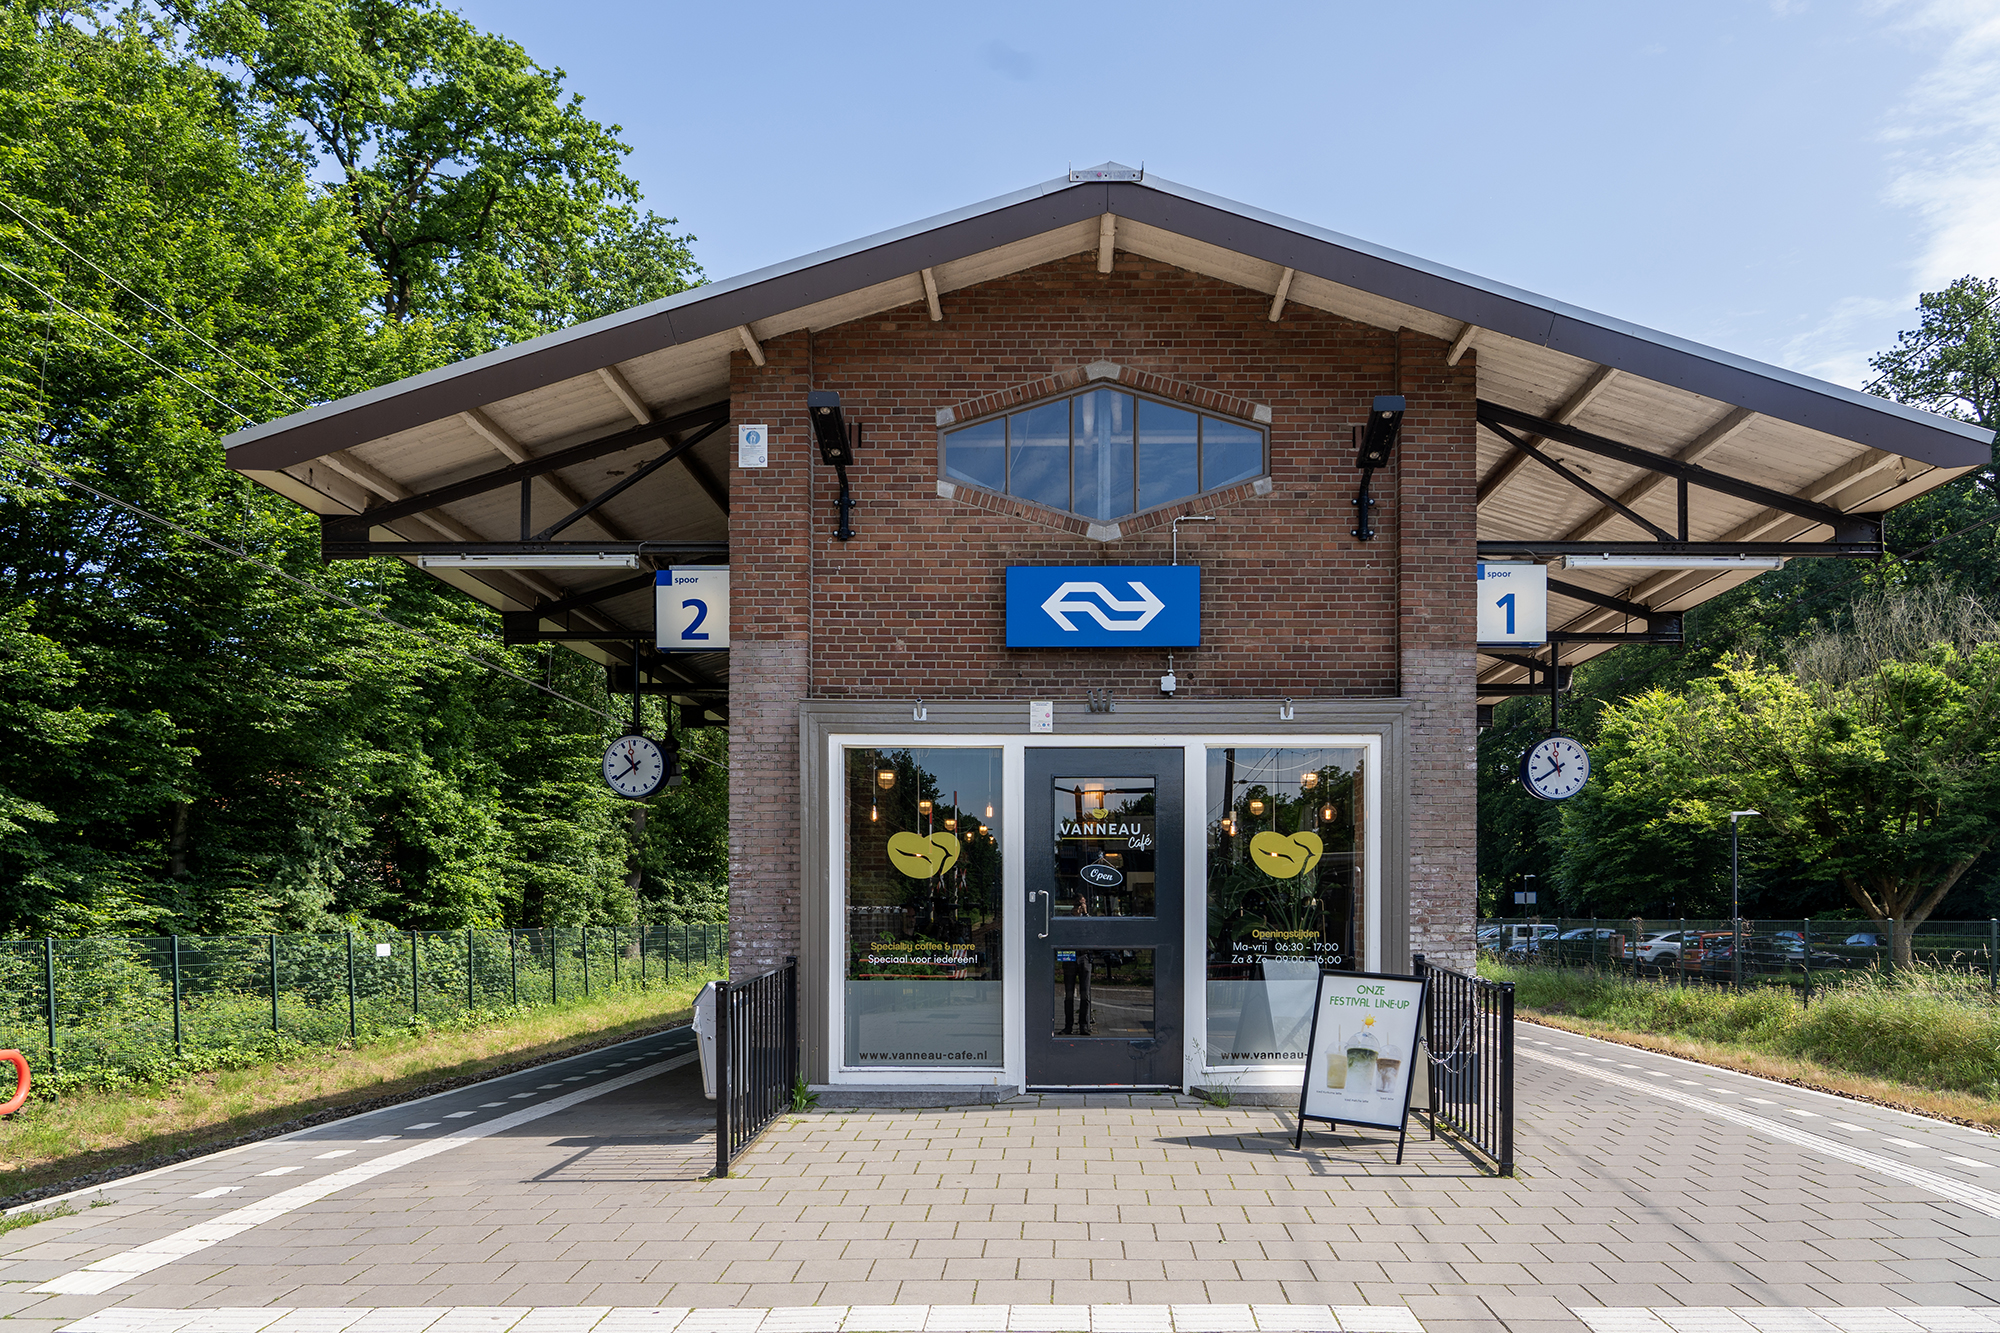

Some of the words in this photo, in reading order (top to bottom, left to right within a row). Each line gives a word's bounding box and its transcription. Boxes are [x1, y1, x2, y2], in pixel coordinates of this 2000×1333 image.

[1487, 571, 1512, 579] spoor
[674, 577, 699, 585] spoor
[681, 598, 709, 640] 2
[1495, 593, 1515, 634] 1
[1060, 823, 1141, 835] VANNEAU
[1128, 833, 1152, 852] Café
[1090, 868, 1113, 881] Open
[1251, 929, 1320, 940] Openingstijden
[870, 941, 913, 952] Specialty
[914, 941, 942, 951] coffee
[944, 942, 951, 951] &
[952, 943, 975, 951] more
[1232, 942, 1268, 953] Ma-vrij
[1275, 942, 1304, 952] 06:30
[1313, 942, 1339, 952] 17:00
[868, 954, 908, 965] Speciaal
[910, 956, 932, 964] voor
[933, 954, 978, 964] iedereen!
[1231, 955, 1244, 964] Za
[1246, 955, 1253, 964] &
[1255, 955, 1268, 964] Zo
[1275, 955, 1305, 964] 09:00
[1314, 955, 1342, 964] 16:00
[1356, 984, 1386, 996] ONZE
[1329, 995, 1370, 1008] FESTIVAL
[1374, 998, 1410, 1010] LINE-UP
[859, 1050, 988, 1060] www.vanneau-cafe.nl
[1221, 1052, 1309, 1060] www.vanneau-
